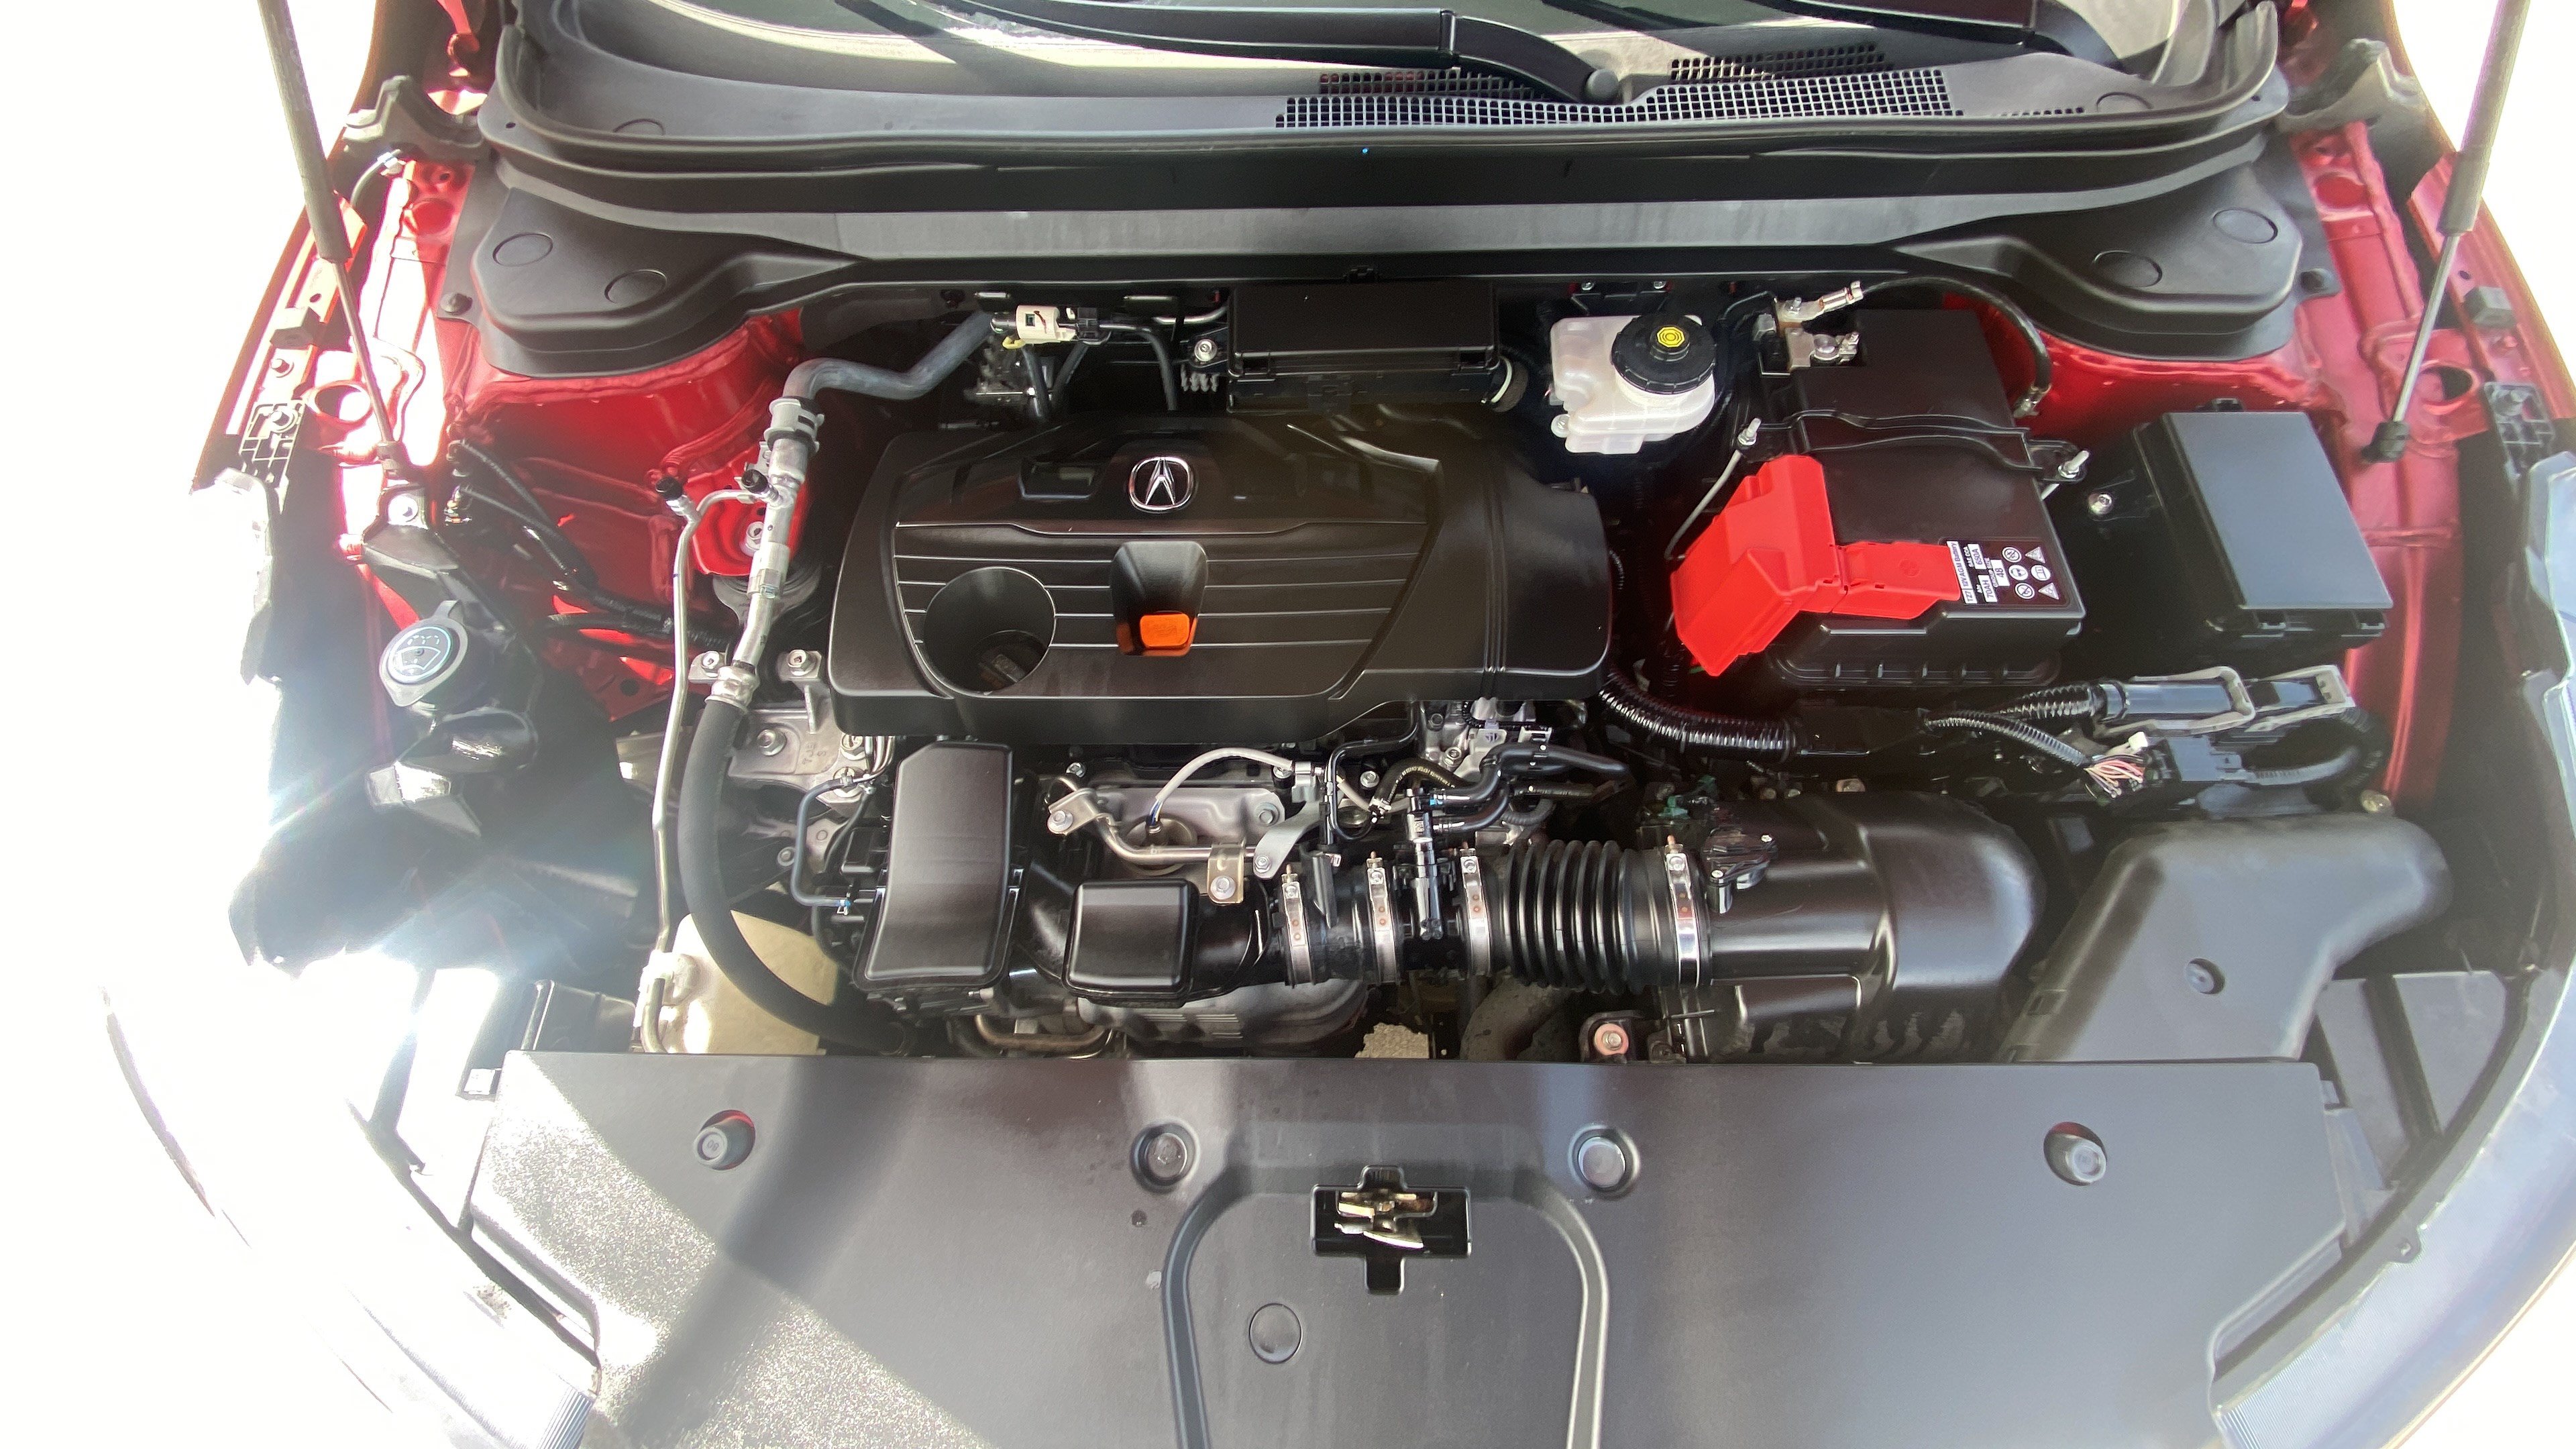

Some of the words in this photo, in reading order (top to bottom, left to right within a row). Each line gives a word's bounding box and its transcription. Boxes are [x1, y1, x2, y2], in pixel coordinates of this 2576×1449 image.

[1951, 542, 1960, 561] Battery
[1955, 563, 1966, 577] AGM
[1995, 568, 2004, 578] 48
[1982, 580, 1994, 598] 70AH
